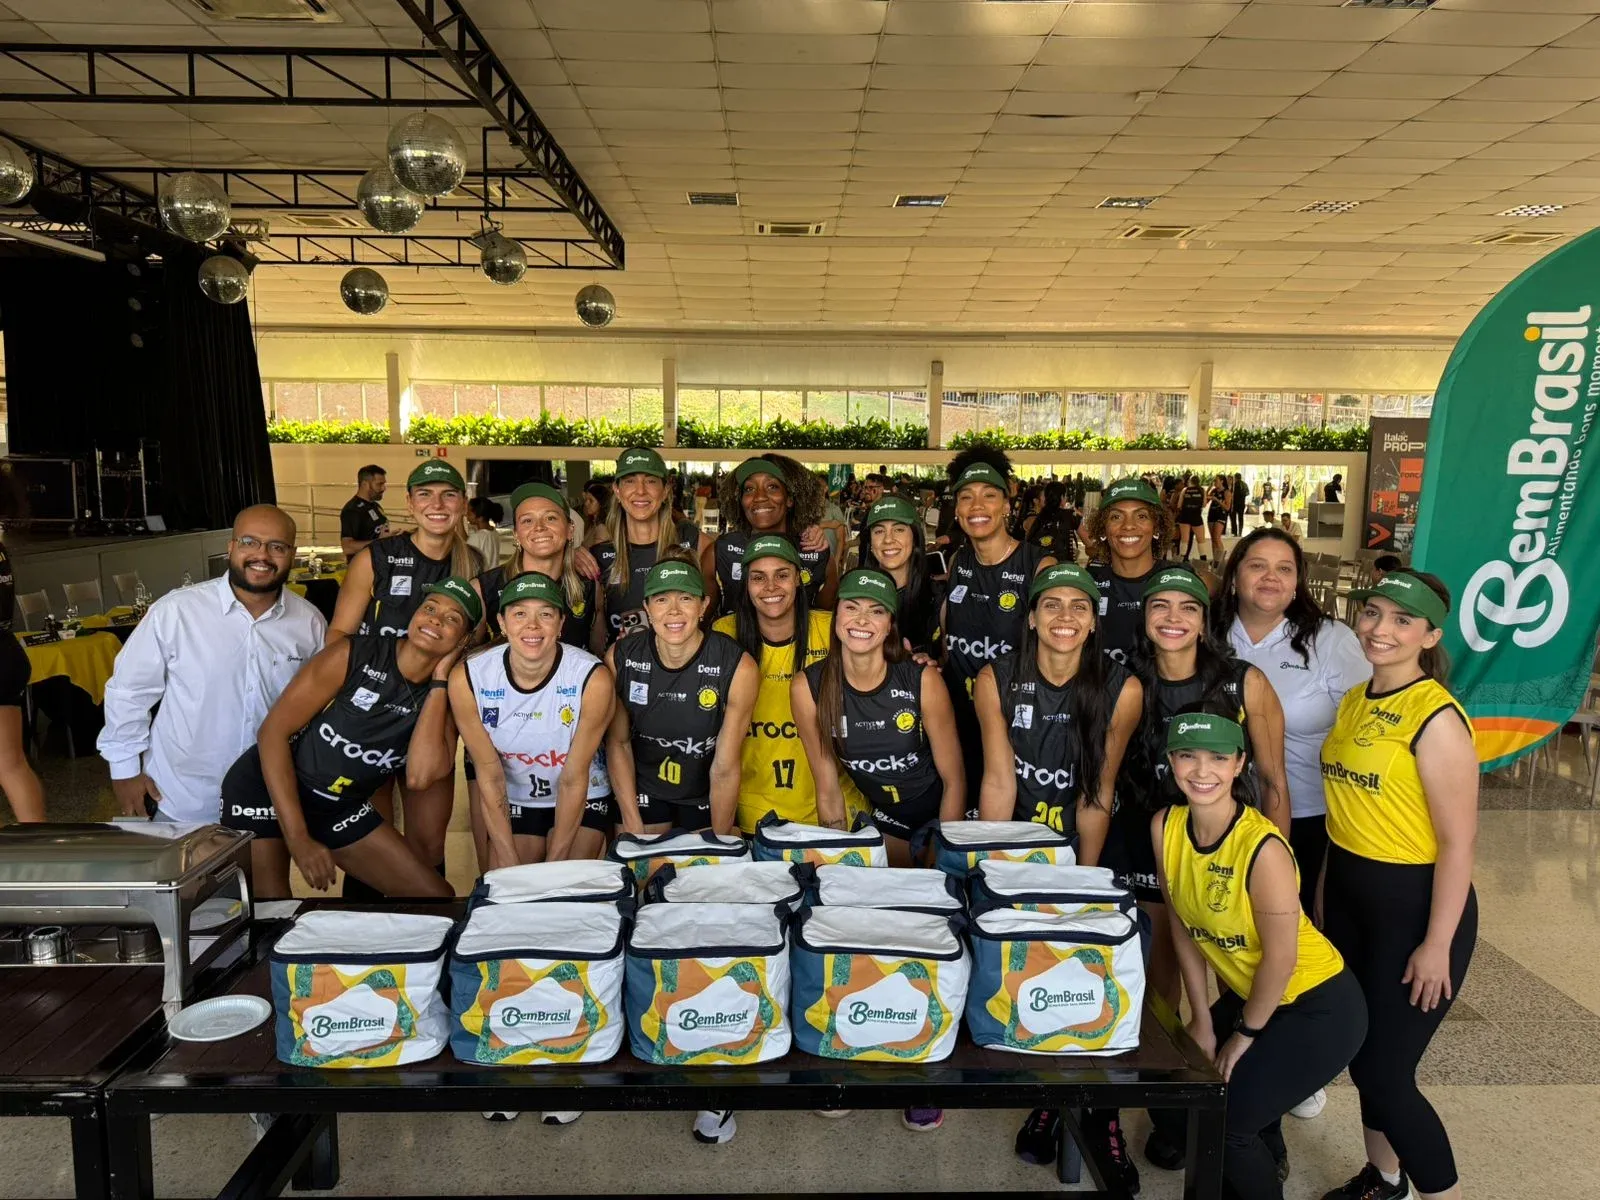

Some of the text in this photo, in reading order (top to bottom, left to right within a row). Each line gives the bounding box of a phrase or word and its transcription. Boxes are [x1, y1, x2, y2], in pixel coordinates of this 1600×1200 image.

[1384, 433, 1408, 442] Italac
[1547, 326, 1600, 556] Alimentando bons mome
[1459, 305, 1591, 652] BemBrasil
[698, 664, 720, 674] Dent
[772, 759, 795, 789] 17
[1320, 756, 1380, 790] emBrasil
[529, 774, 552, 798] 15
[232, 805, 277, 816] Dent
[1029, 987, 1096, 1012] BemBrasil
[501, 1007, 571, 1027] BemBrasil
[678, 1009, 749, 1031] BemBrasil
[848, 1001, 918, 1026] BemBrasil
[311, 1015, 385, 1038] BemBrasil
